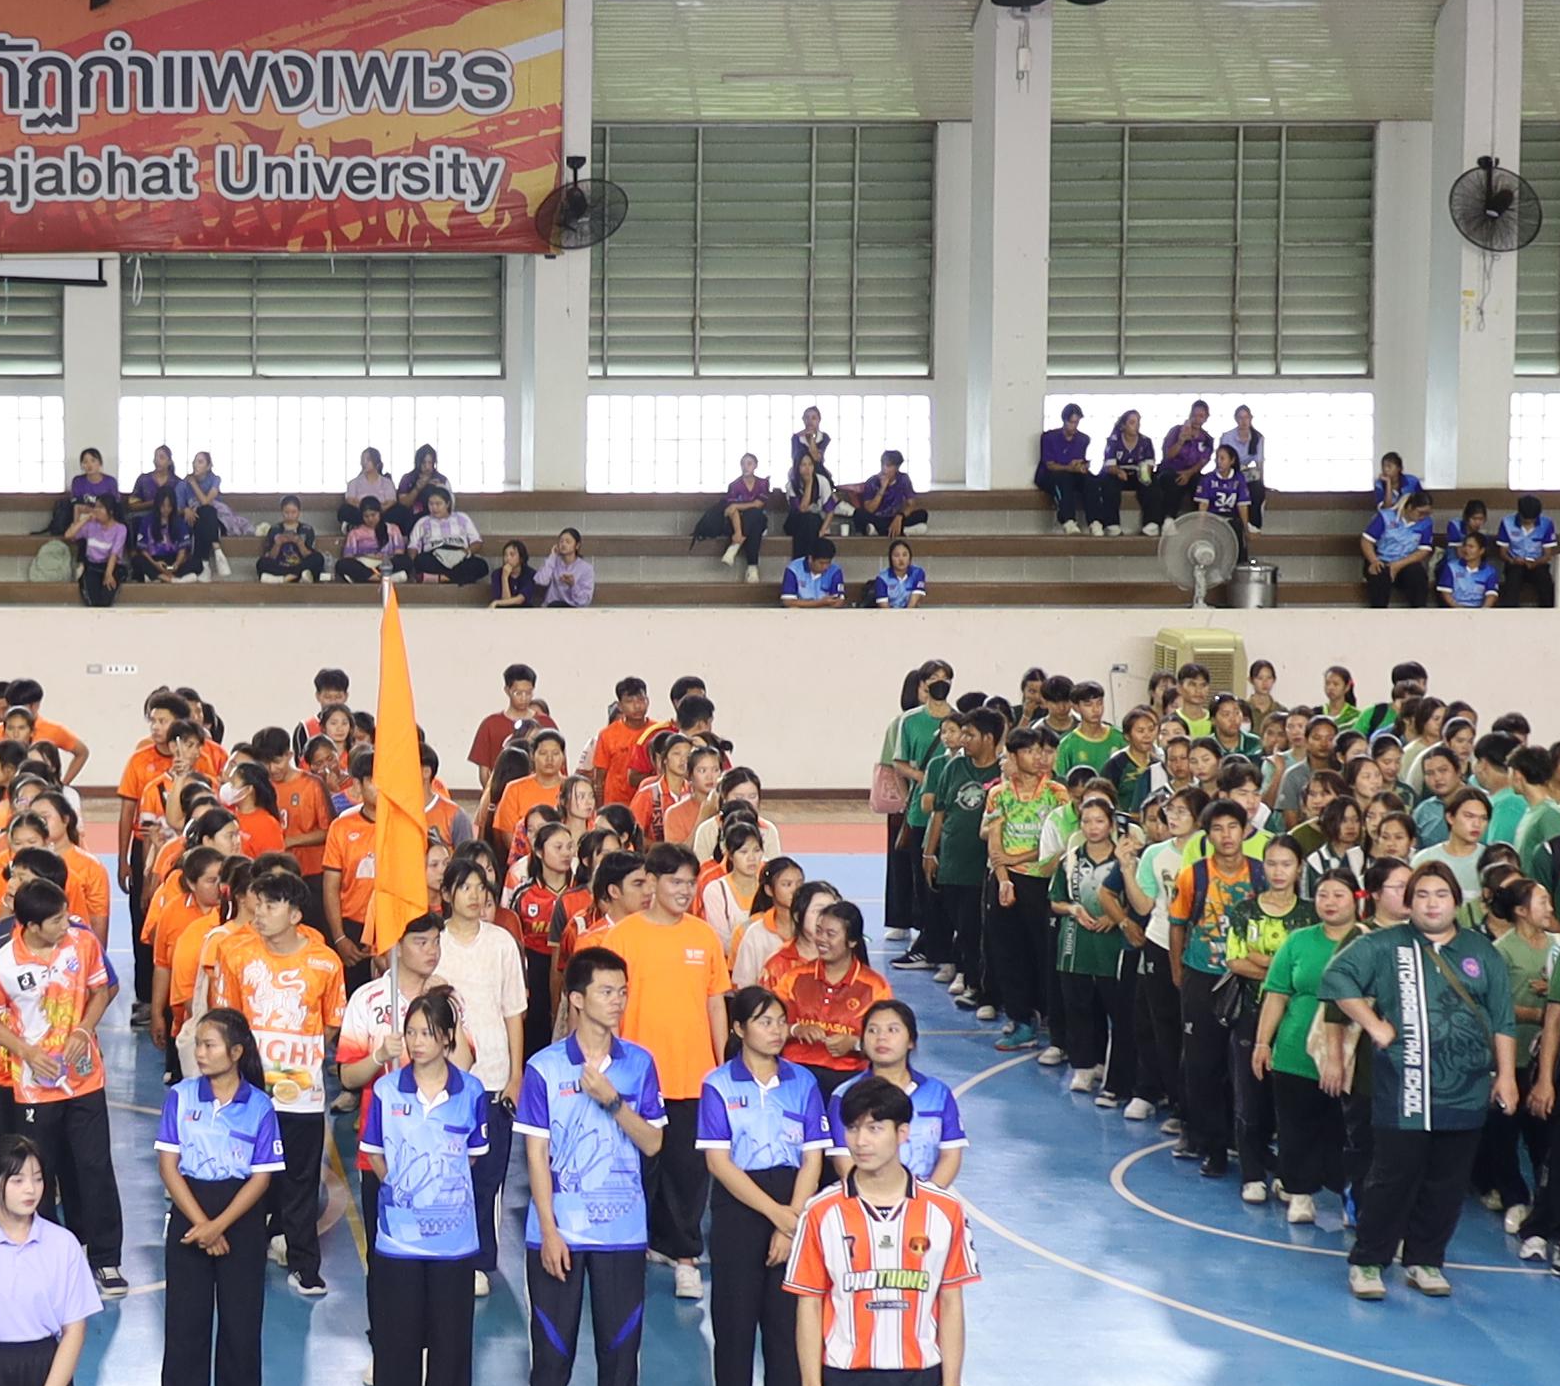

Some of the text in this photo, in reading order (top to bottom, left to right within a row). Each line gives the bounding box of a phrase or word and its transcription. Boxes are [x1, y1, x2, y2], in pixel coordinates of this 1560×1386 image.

[214, 147, 502, 212] University
[1214, 492, 1236, 507] 34
[1402, 1064, 1423, 1119] SCHOOL
